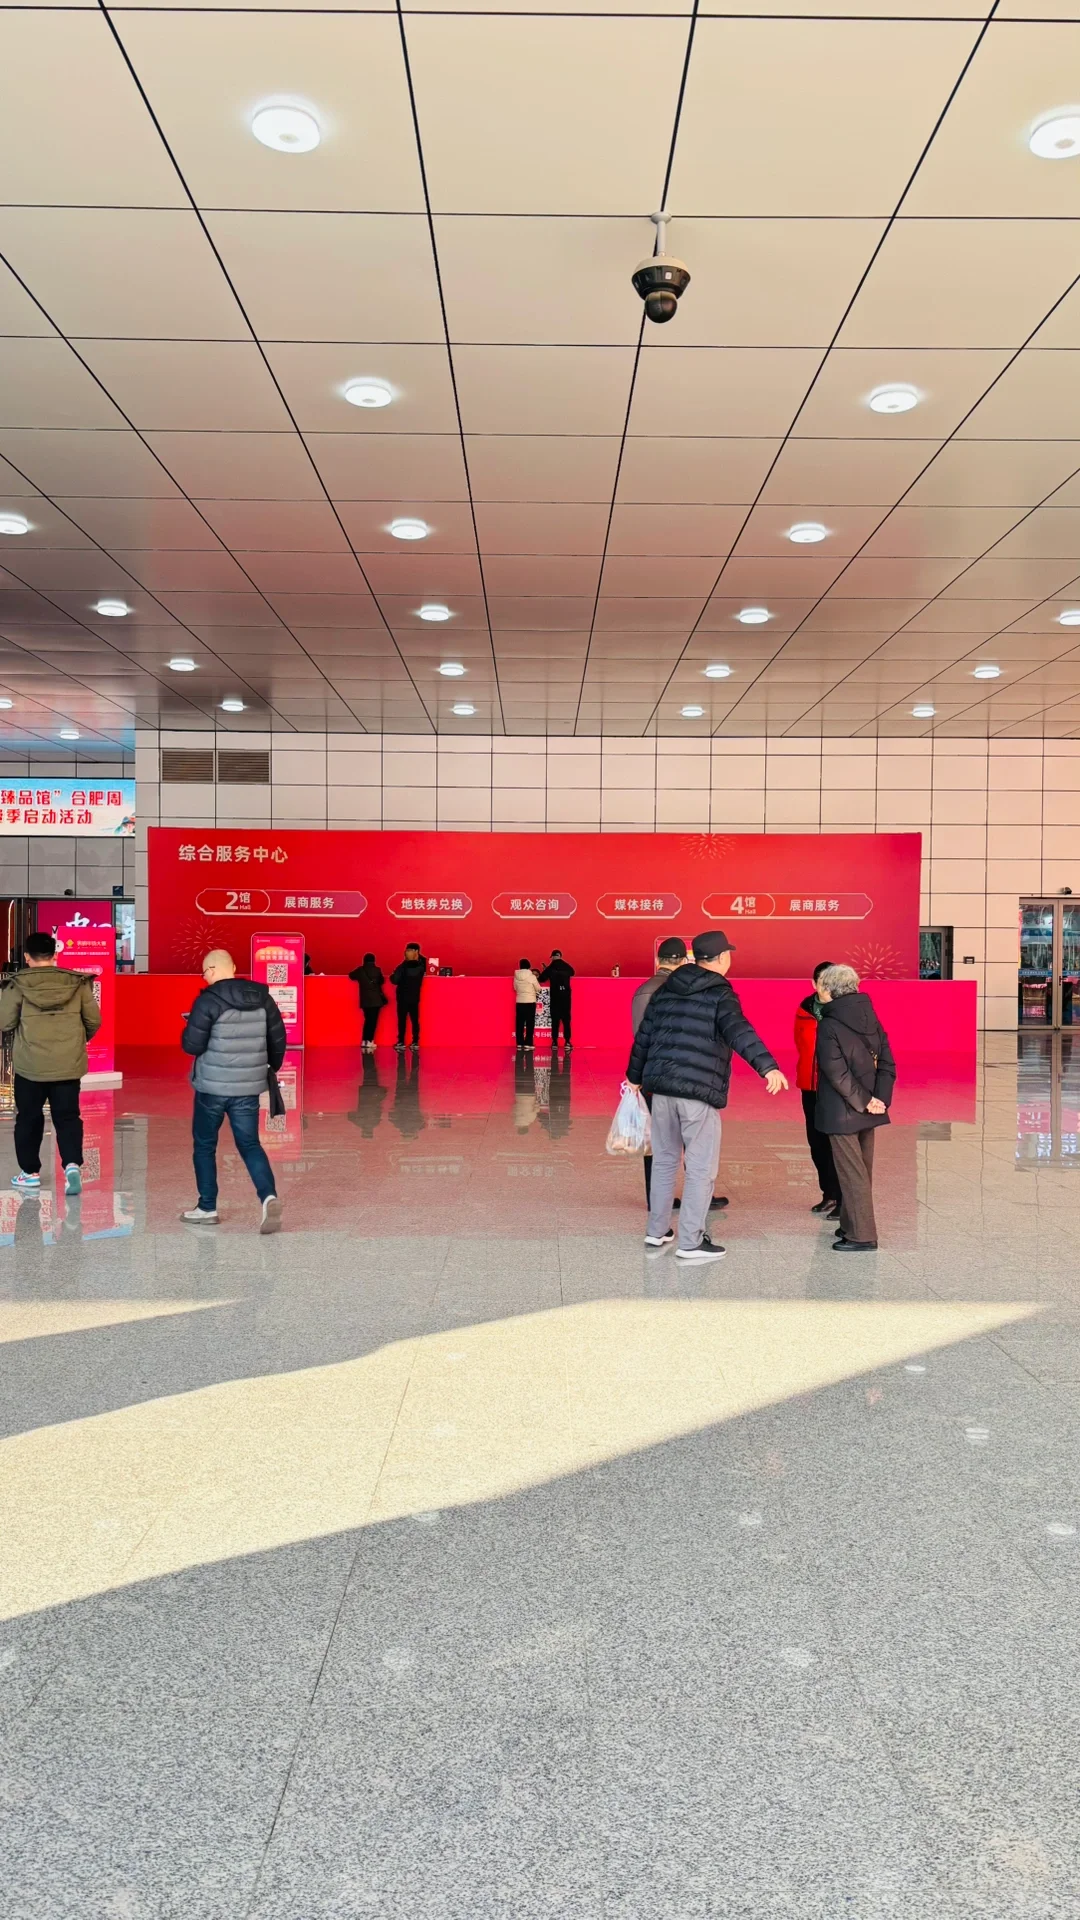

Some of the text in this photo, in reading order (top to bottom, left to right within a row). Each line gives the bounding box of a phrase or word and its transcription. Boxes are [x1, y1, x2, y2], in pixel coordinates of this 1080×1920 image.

[0, 809, 92, 825] 季启动活动
[178, 844, 288, 863] 综合服务中心
[284, 896, 335, 909] 展商服务
[401, 897, 464, 910] 地铁券兑换
[510, 898, 559, 911] 观众咨询
[614, 899, 664, 911] 媒体接待
[789, 899, 840, 912] 展商服务
